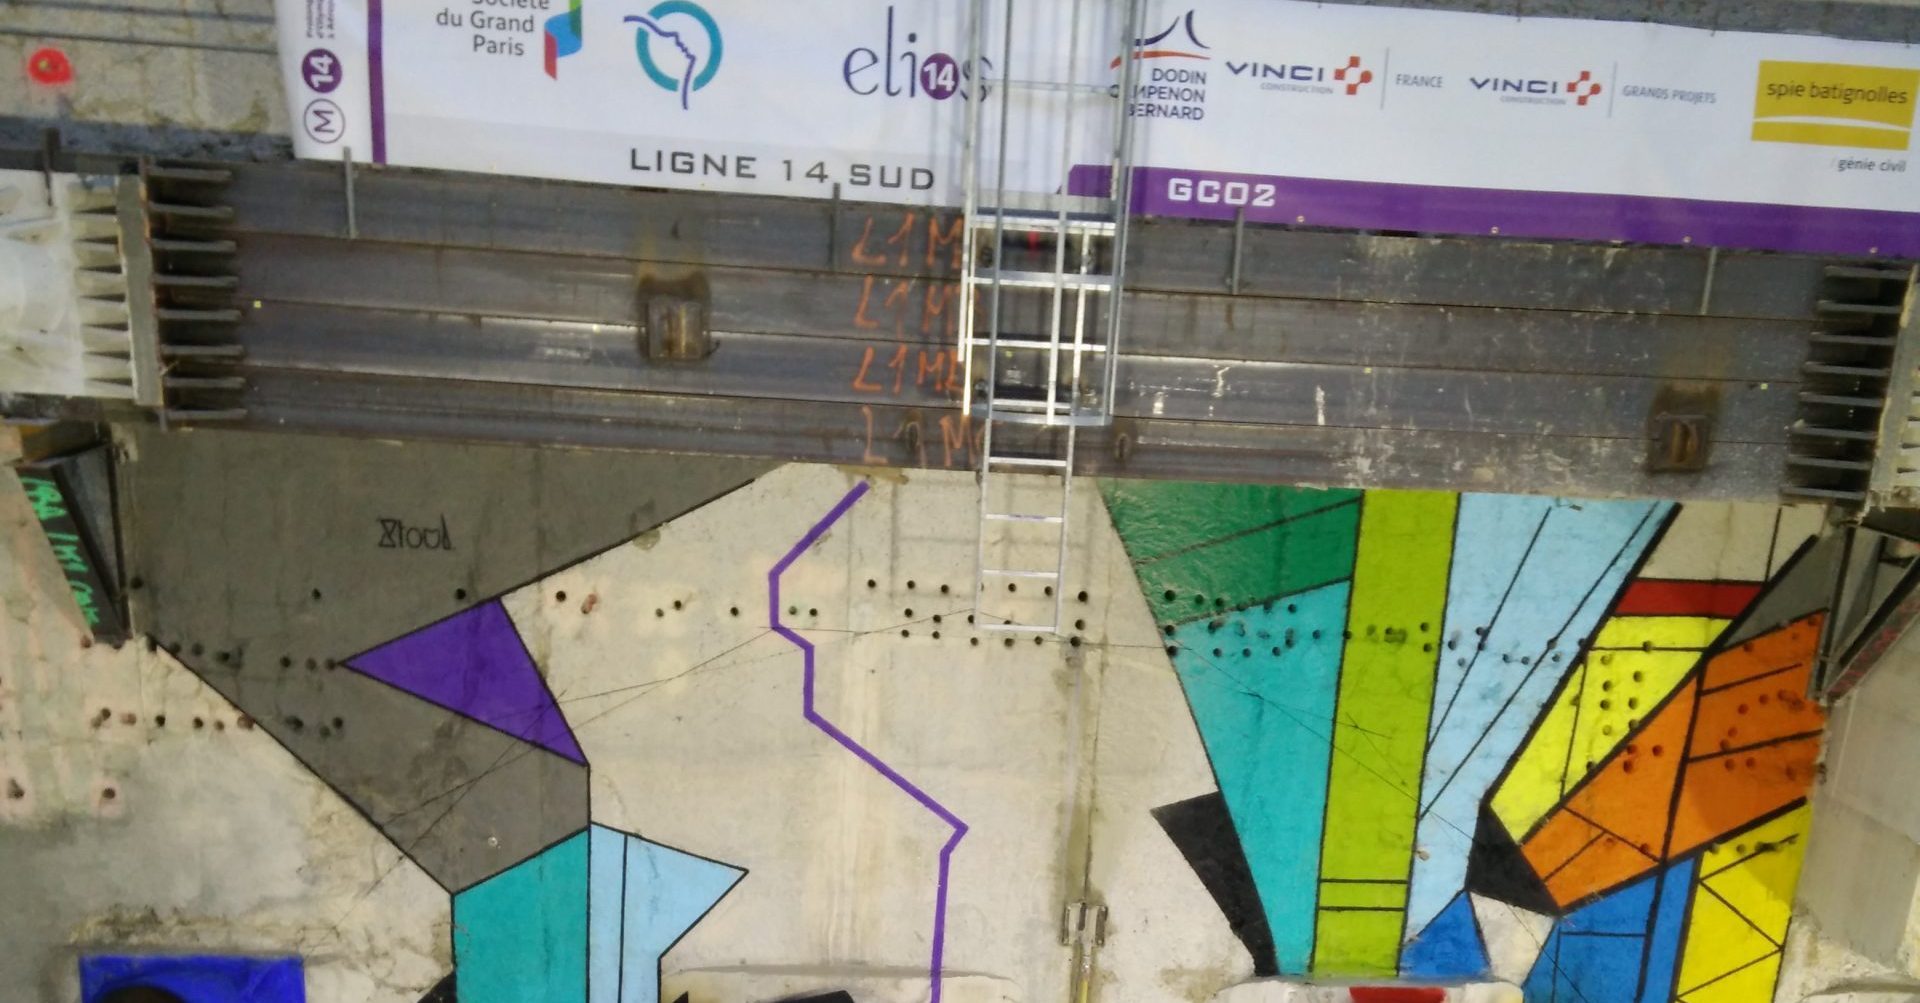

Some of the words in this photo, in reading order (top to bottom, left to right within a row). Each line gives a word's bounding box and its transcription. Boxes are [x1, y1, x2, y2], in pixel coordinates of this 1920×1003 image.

[436, 8, 462, 27] du
[470, 10, 534, 33] Grand
[473, 34, 524, 56] Paris
[309, 54, 334, 88] 14
[1152, 67, 1207, 85] DODIN
[1225, 60, 1324, 82] VINCI
[1396, 73, 1443, 88] FRANCE
[1109, 84, 1205, 103] CMPENON
[1469, 76, 1557, 94] VINCI
[1622, 84, 1669, 99] GRANDS
[1672, 89, 1717, 105] PROJETS
[1767, 80, 1805, 101] spie
[1810, 82, 1908, 105] batignolles
[631, 147, 757, 179] LIGNE
[782, 159, 828, 183] 14
[849, 164, 934, 190] SUD
[1838, 156, 1876, 172] génie
[1879, 158, 1907, 173] civil
